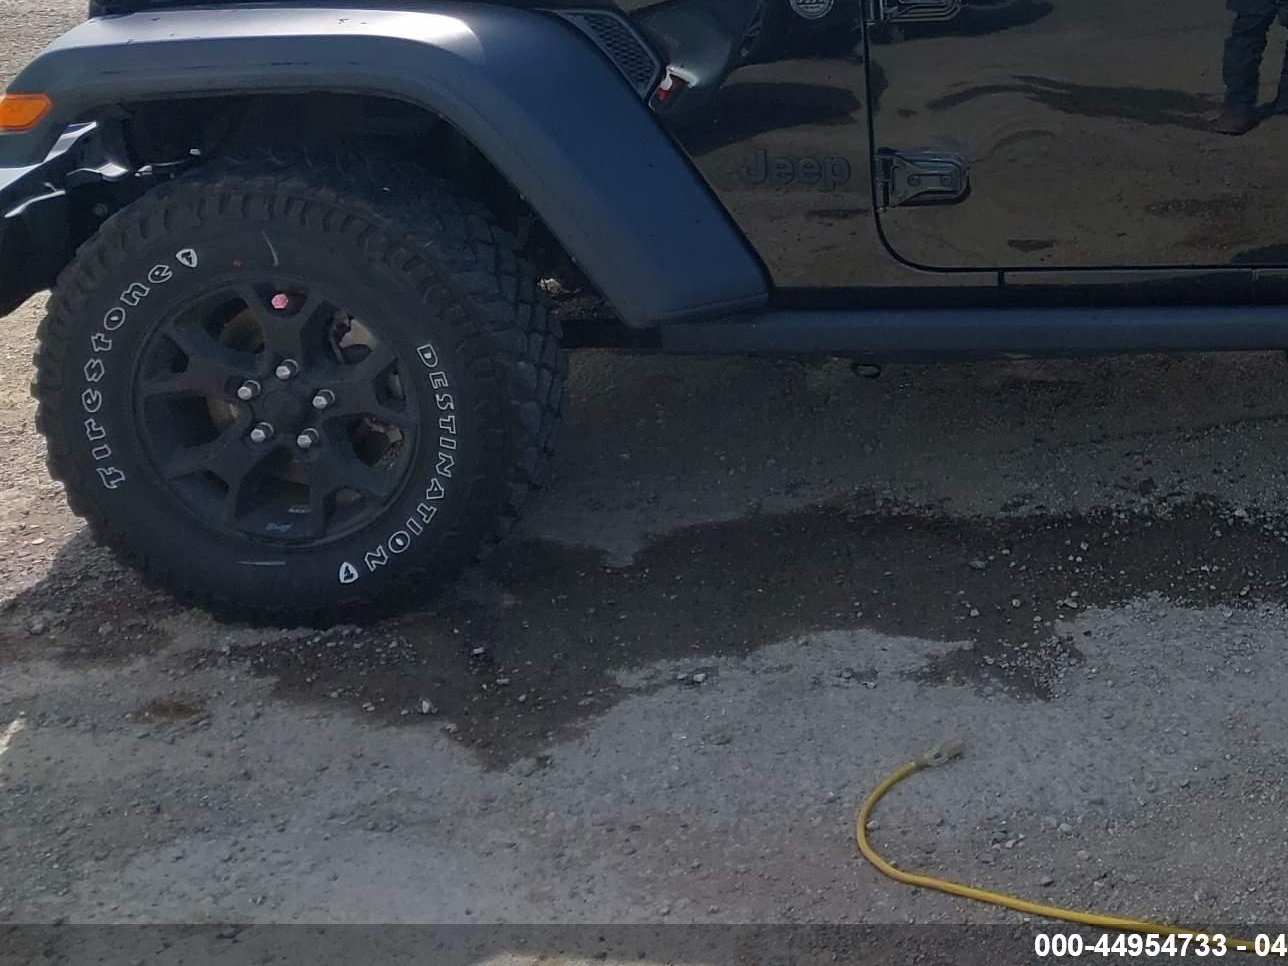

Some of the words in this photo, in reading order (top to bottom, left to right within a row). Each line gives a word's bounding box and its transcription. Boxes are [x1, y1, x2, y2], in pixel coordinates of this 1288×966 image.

[739, 148, 852, 192] Jeep
[82, 264, 172, 489] Firestone
[365, 344, 457, 573] DESTINATION
